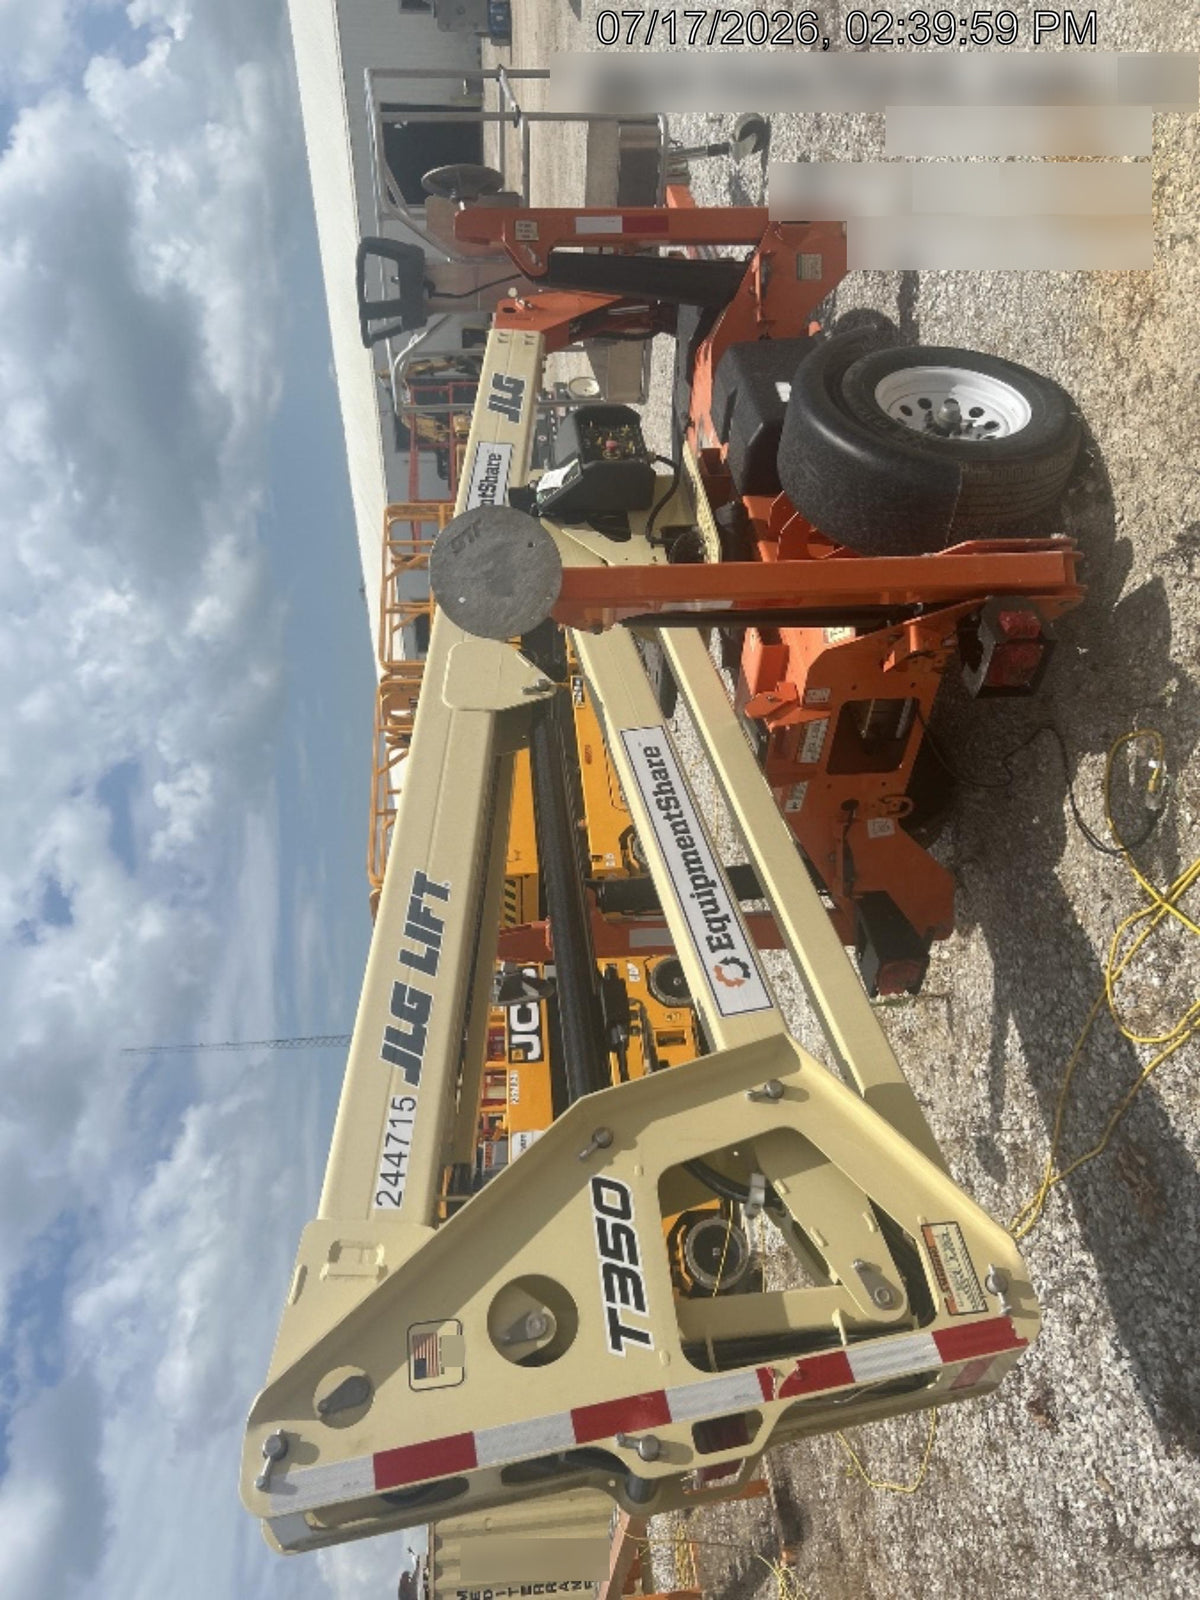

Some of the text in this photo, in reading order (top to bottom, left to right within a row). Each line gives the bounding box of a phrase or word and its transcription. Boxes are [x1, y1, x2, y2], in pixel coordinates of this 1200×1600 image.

[488, 373, 524, 423] JLG
[642, 745, 735, 954] EquipmentShare
[381, 870, 449, 1086] JLG LIFT
[376, 1096, 416, 1207] 244715
[591, 1177, 652, 1352] T350
